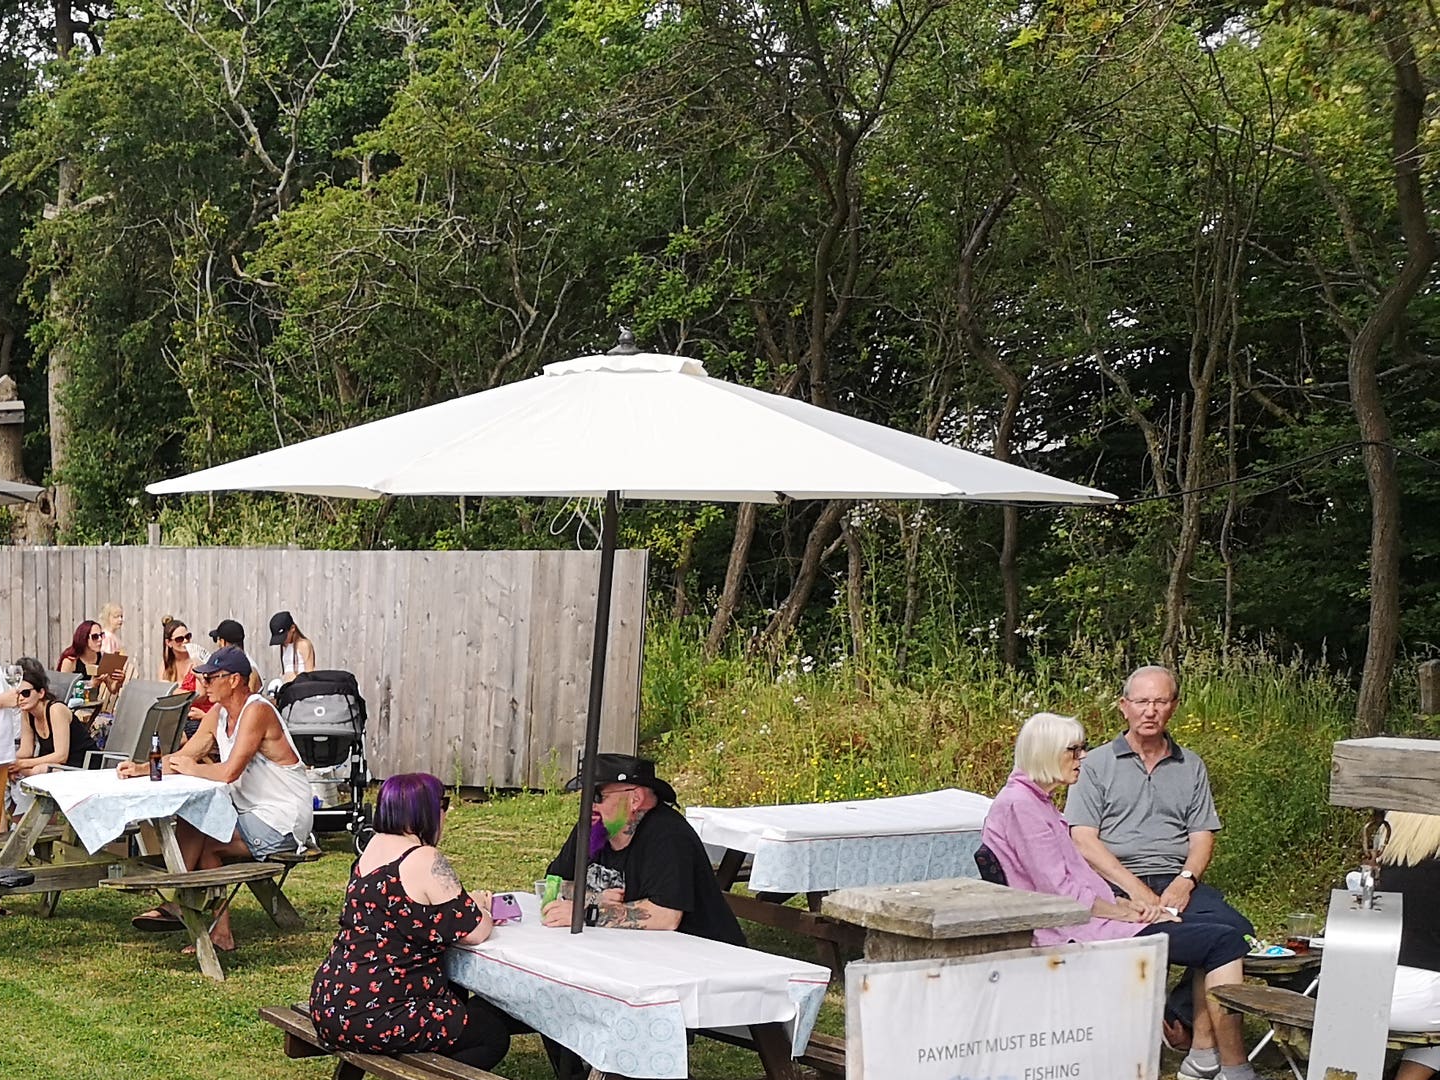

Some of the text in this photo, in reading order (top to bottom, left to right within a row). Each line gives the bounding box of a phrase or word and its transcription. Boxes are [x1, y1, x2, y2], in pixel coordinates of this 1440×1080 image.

[918, 1027, 1094, 1063] PAYMENT MUST BE MADE
